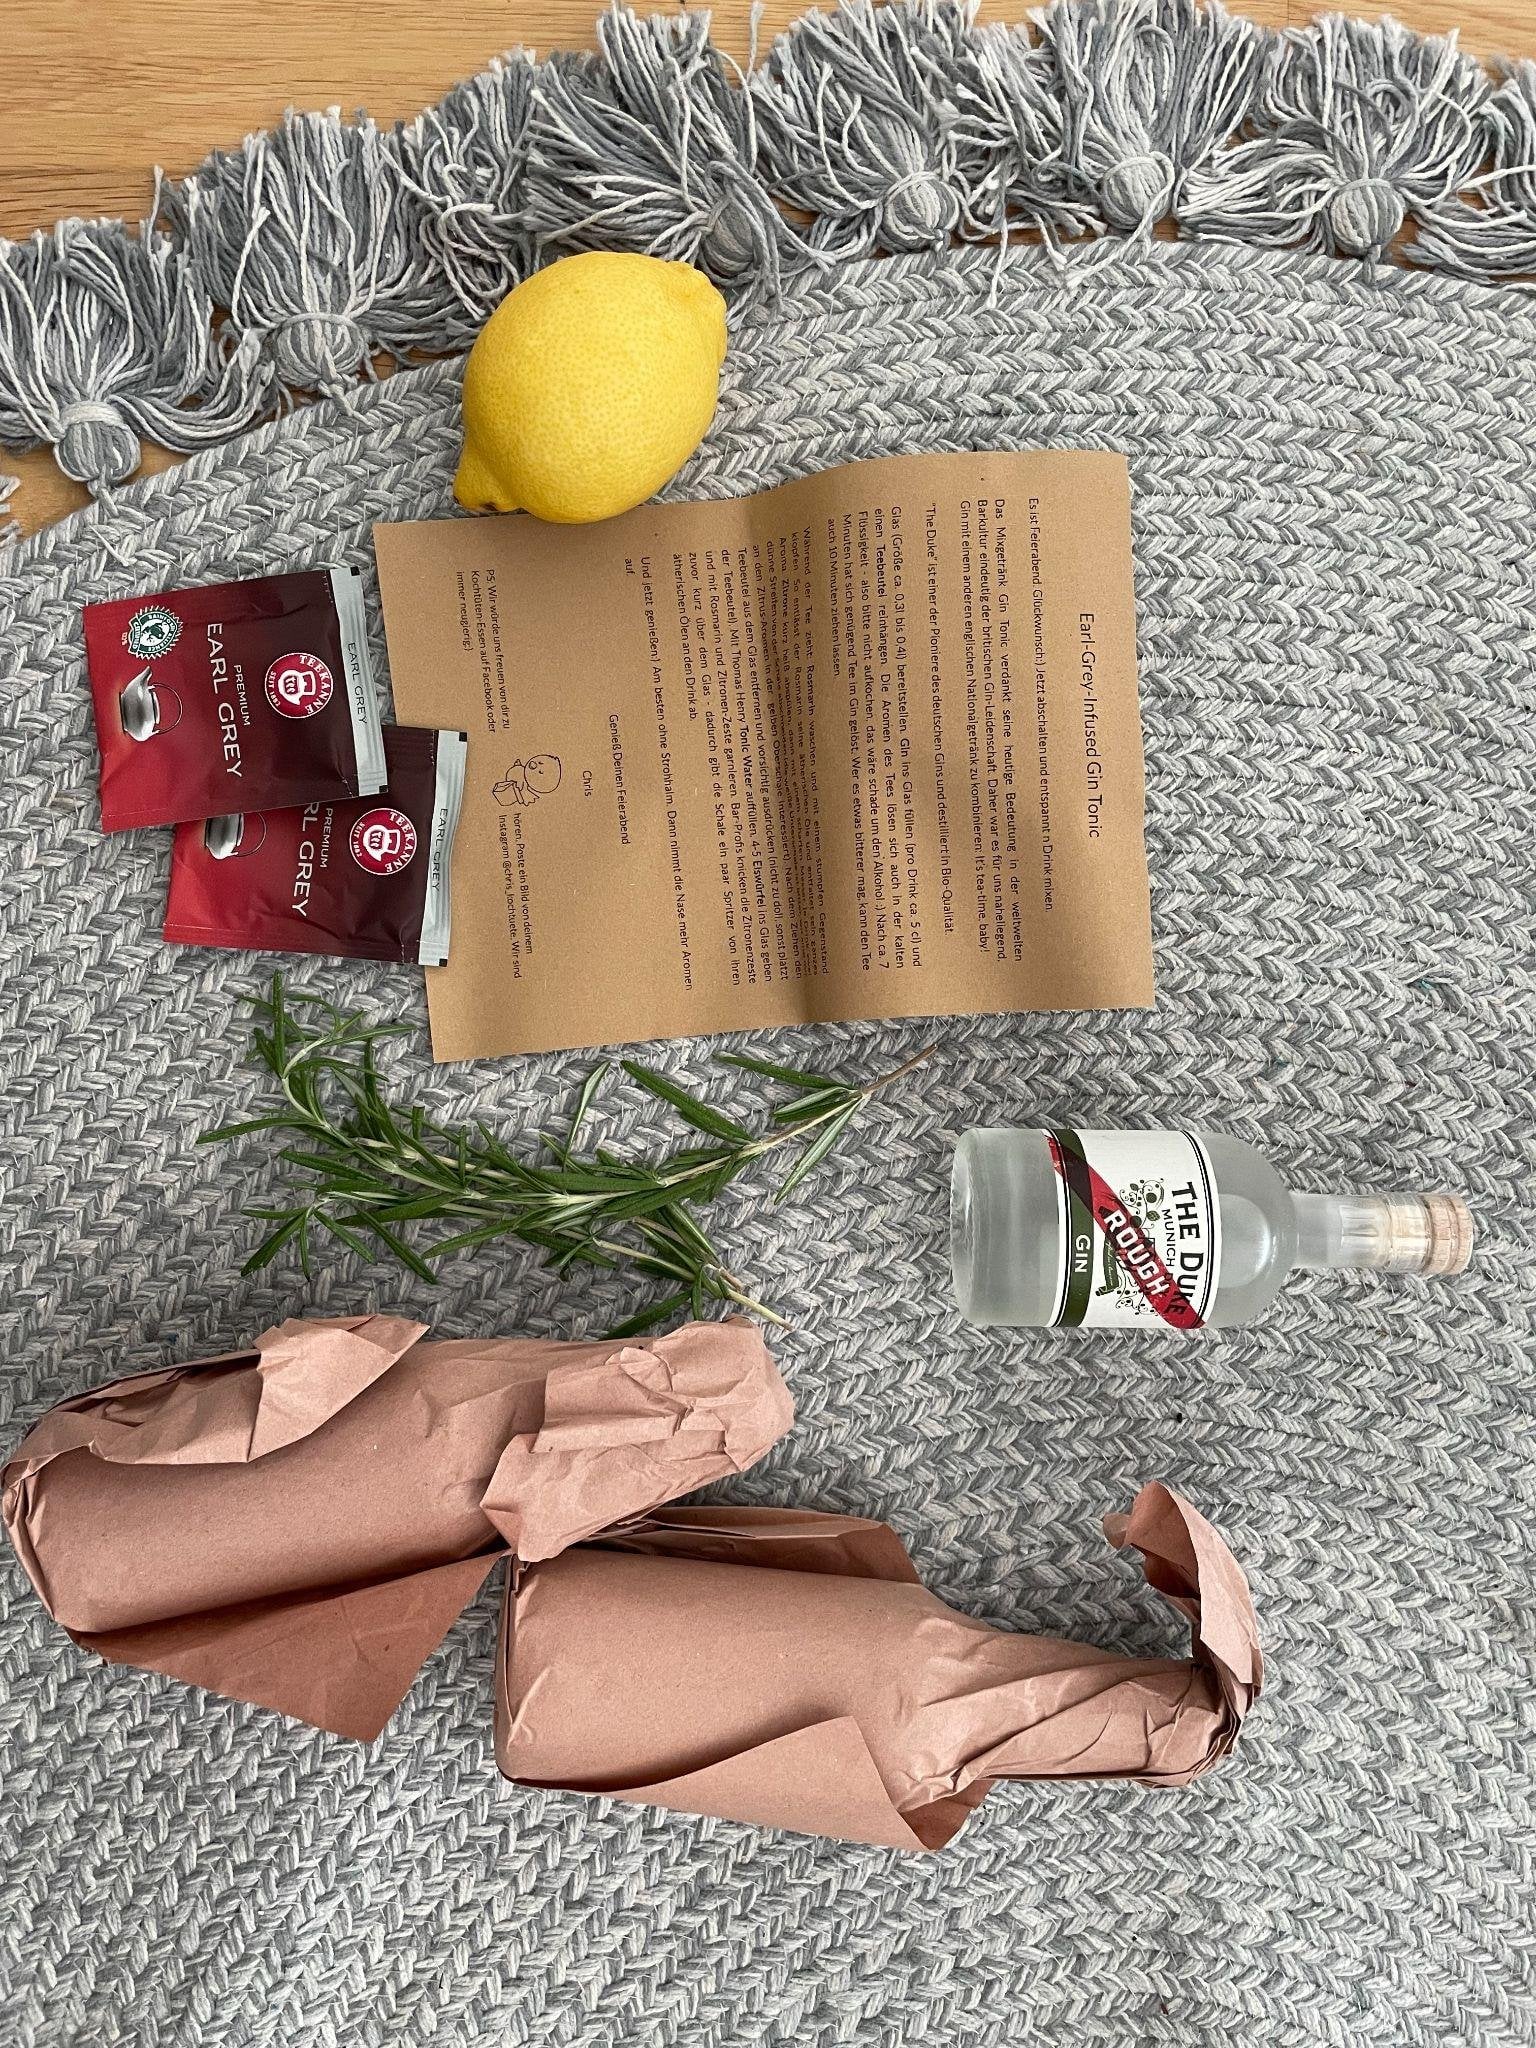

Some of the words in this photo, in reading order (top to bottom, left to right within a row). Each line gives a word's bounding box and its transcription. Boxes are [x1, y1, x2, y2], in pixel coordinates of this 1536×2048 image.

[960, 500, 971, 518] Gin
[995, 498, 1006, 519] Das
[1029, 497, 1040, 510] Es
[1030, 511, 1039, 524] ist
[961, 520, 972, 538] mit
[978, 499, 990, 550] Barkultur
[641, 556, 653, 578] Und
[705, 550, 717, 570] und
[721, 549, 732, 566] der
[928, 563, 938, 576] ist
[962, 540, 973, 572] einem
[995, 526, 1009, 586] Mixgetränk
[456, 571, 466, 601] immer
[708, 574, 718, 591] mit
[928, 578, 939, 606] einer
[979, 552, 992, 602] eindeutig
[488, 584, 498, 603] Wir
[642, 582, 654, 606] jetzt
[963, 574, 974, 618] anderen
[998, 593, 1010, 612] Gin
[471, 570, 487, 648] Kochtüten-Essen
[710, 595, 724, 644] Rosmarin
[929, 607, 940, 625] der
[981, 604, 992, 622] der
[730, 629, 740, 646] Mit
[1000, 619, 1011, 648] Tonic
[1032, 589, 1047, 666] Glückwunsch:)
[480, 650, 490, 665] auf
[493, 636, 502, 652] uns
[715, 646, 727, 666] und
[930, 628, 942, 672] Pioniere
[963, 620, 977, 676] englischen
[982, 624, 994, 679] britischen
[268, 671, 277, 688] SEIT
[348, 642, 359, 680] EARL
[354, 686, 368, 724] GREY
[496, 654, 505, 684] freuen
[653, 666, 662, 683] Am
[732, 649, 743, 690] Thomas
[931, 674, 942, 693] des
[1000, 653, 1013, 702] verdankt
[1036, 667, 1047, 694] Jetzt
[234, 664, 250, 726] PREMIUM
[300, 655, 330, 714] TEEKANNE
[482, 666, 495, 710] Facebook
[499, 685, 507, 702] von
[1080, 613, 1102, 756] Earl-Grey-Infused
[207, 623, 228, 694] EARL
[218, 702, 242, 778] GREY
[501, 704, 510, 717] dir
[654, 686, 665, 720] besten
[717, 669, 733, 744] Zitronen-Zeste
[736, 691, 747, 723] Henry
[487, 711, 497, 733] oder
[502, 718, 511, 729] zu
[609, 714, 622, 750] Genieß
[658, 723, 669, 748] ohne
[932, 695, 944, 750] deutschen
[966, 678, 980, 766] Nationalgetränk
[1002, 709, 1015, 738] seine
[1037, 696, 1049, 754] abschalten
[740, 724, 751, 752] Tonic
[613, 751, 624, 788] Deinen
[743, 754, 753, 788] Water
[935, 752, 946, 777] Gins
[970, 767, 979, 780] zu
[1003, 744, 1016, 785] heutige
[1039, 755, 1051, 776] und
[1087, 761, 1104, 790] Gin
[582, 770, 594, 796] Chris
[936, 779, 947, 799] und
[987, 778, 999, 812] Daher
[302, 802, 320, 832] RL
[617, 789, 632, 844] Feierabend
[971, 782, 984, 852] kombinieren:
[1039, 778, 1051, 832] entspannt
[1088, 793, 1103, 838] Tonic
[354, 822, 366, 838] SEIT
[436, 808, 448, 846] EARL
[499, 814, 510, 858] Instagram
[667, 810, 678, 838] Dann
[731, 802, 745, 854] Bar-Profis
[937, 801, 950, 853] destilliert
[990, 815, 999, 836] war
[1006, 792, 1017, 852] Bedeutung
[320, 808, 334, 868] PREMIUM
[384, 812, 414, 872] TEEKANNE
[751, 840, 762, 856] 4-5
[991, 839, 1000, 852] es
[516, 843, 526, 868] Poste
[670, 840, 683, 872] nimmt
[941, 855, 951, 866] in
[993, 854, 1003, 870] für
[1010, 858, 1020, 869] in
[1043, 844, 1054, 875] Drink
[292, 841, 314, 917] GREY
[432, 851, 440, 892] GREY
[519, 869, 528, 884] ein
[674, 875, 684, 890] die
[737, 855, 748, 894] knicken
[753, 859, 767, 908] Eiswürfel
[993, 873, 1002, 893] uns
[1010, 875, 1021, 894] der
[520, 884, 531, 902] Bild
[676, 893, 686, 918] Nase
[741, 896, 751, 912] die
[941, 867, 955, 935] Bio-Qualität.
[1044, 877, 1055, 913] mixen.
[522, 903, 530, 920] von
[758, 910, 767, 924] ins
[523, 921, 533, 954] deinem
[679, 921, 690, 948] mehr
[760, 926, 770, 949] Glas
[978, 923, 991, 952] baby!
[1012, 901, 1024, 961] weltweiten
[511, 940, 521, 958] Wir
[742, 914, 757, 984] Zitronenzeste
[513, 959, 523, 978] sind
[682, 950, 693, 990] Aromen
[760, 951, 773, 982] geben
[1172, 1182, 1200, 1240] THE
[1104, 1210, 1170, 1296] ROUGH
[1162, 1209, 1176, 1267] MUNICH
[1074, 1234, 1090, 1273] GIN
[1164, 1252, 1204, 1315] DUKE
